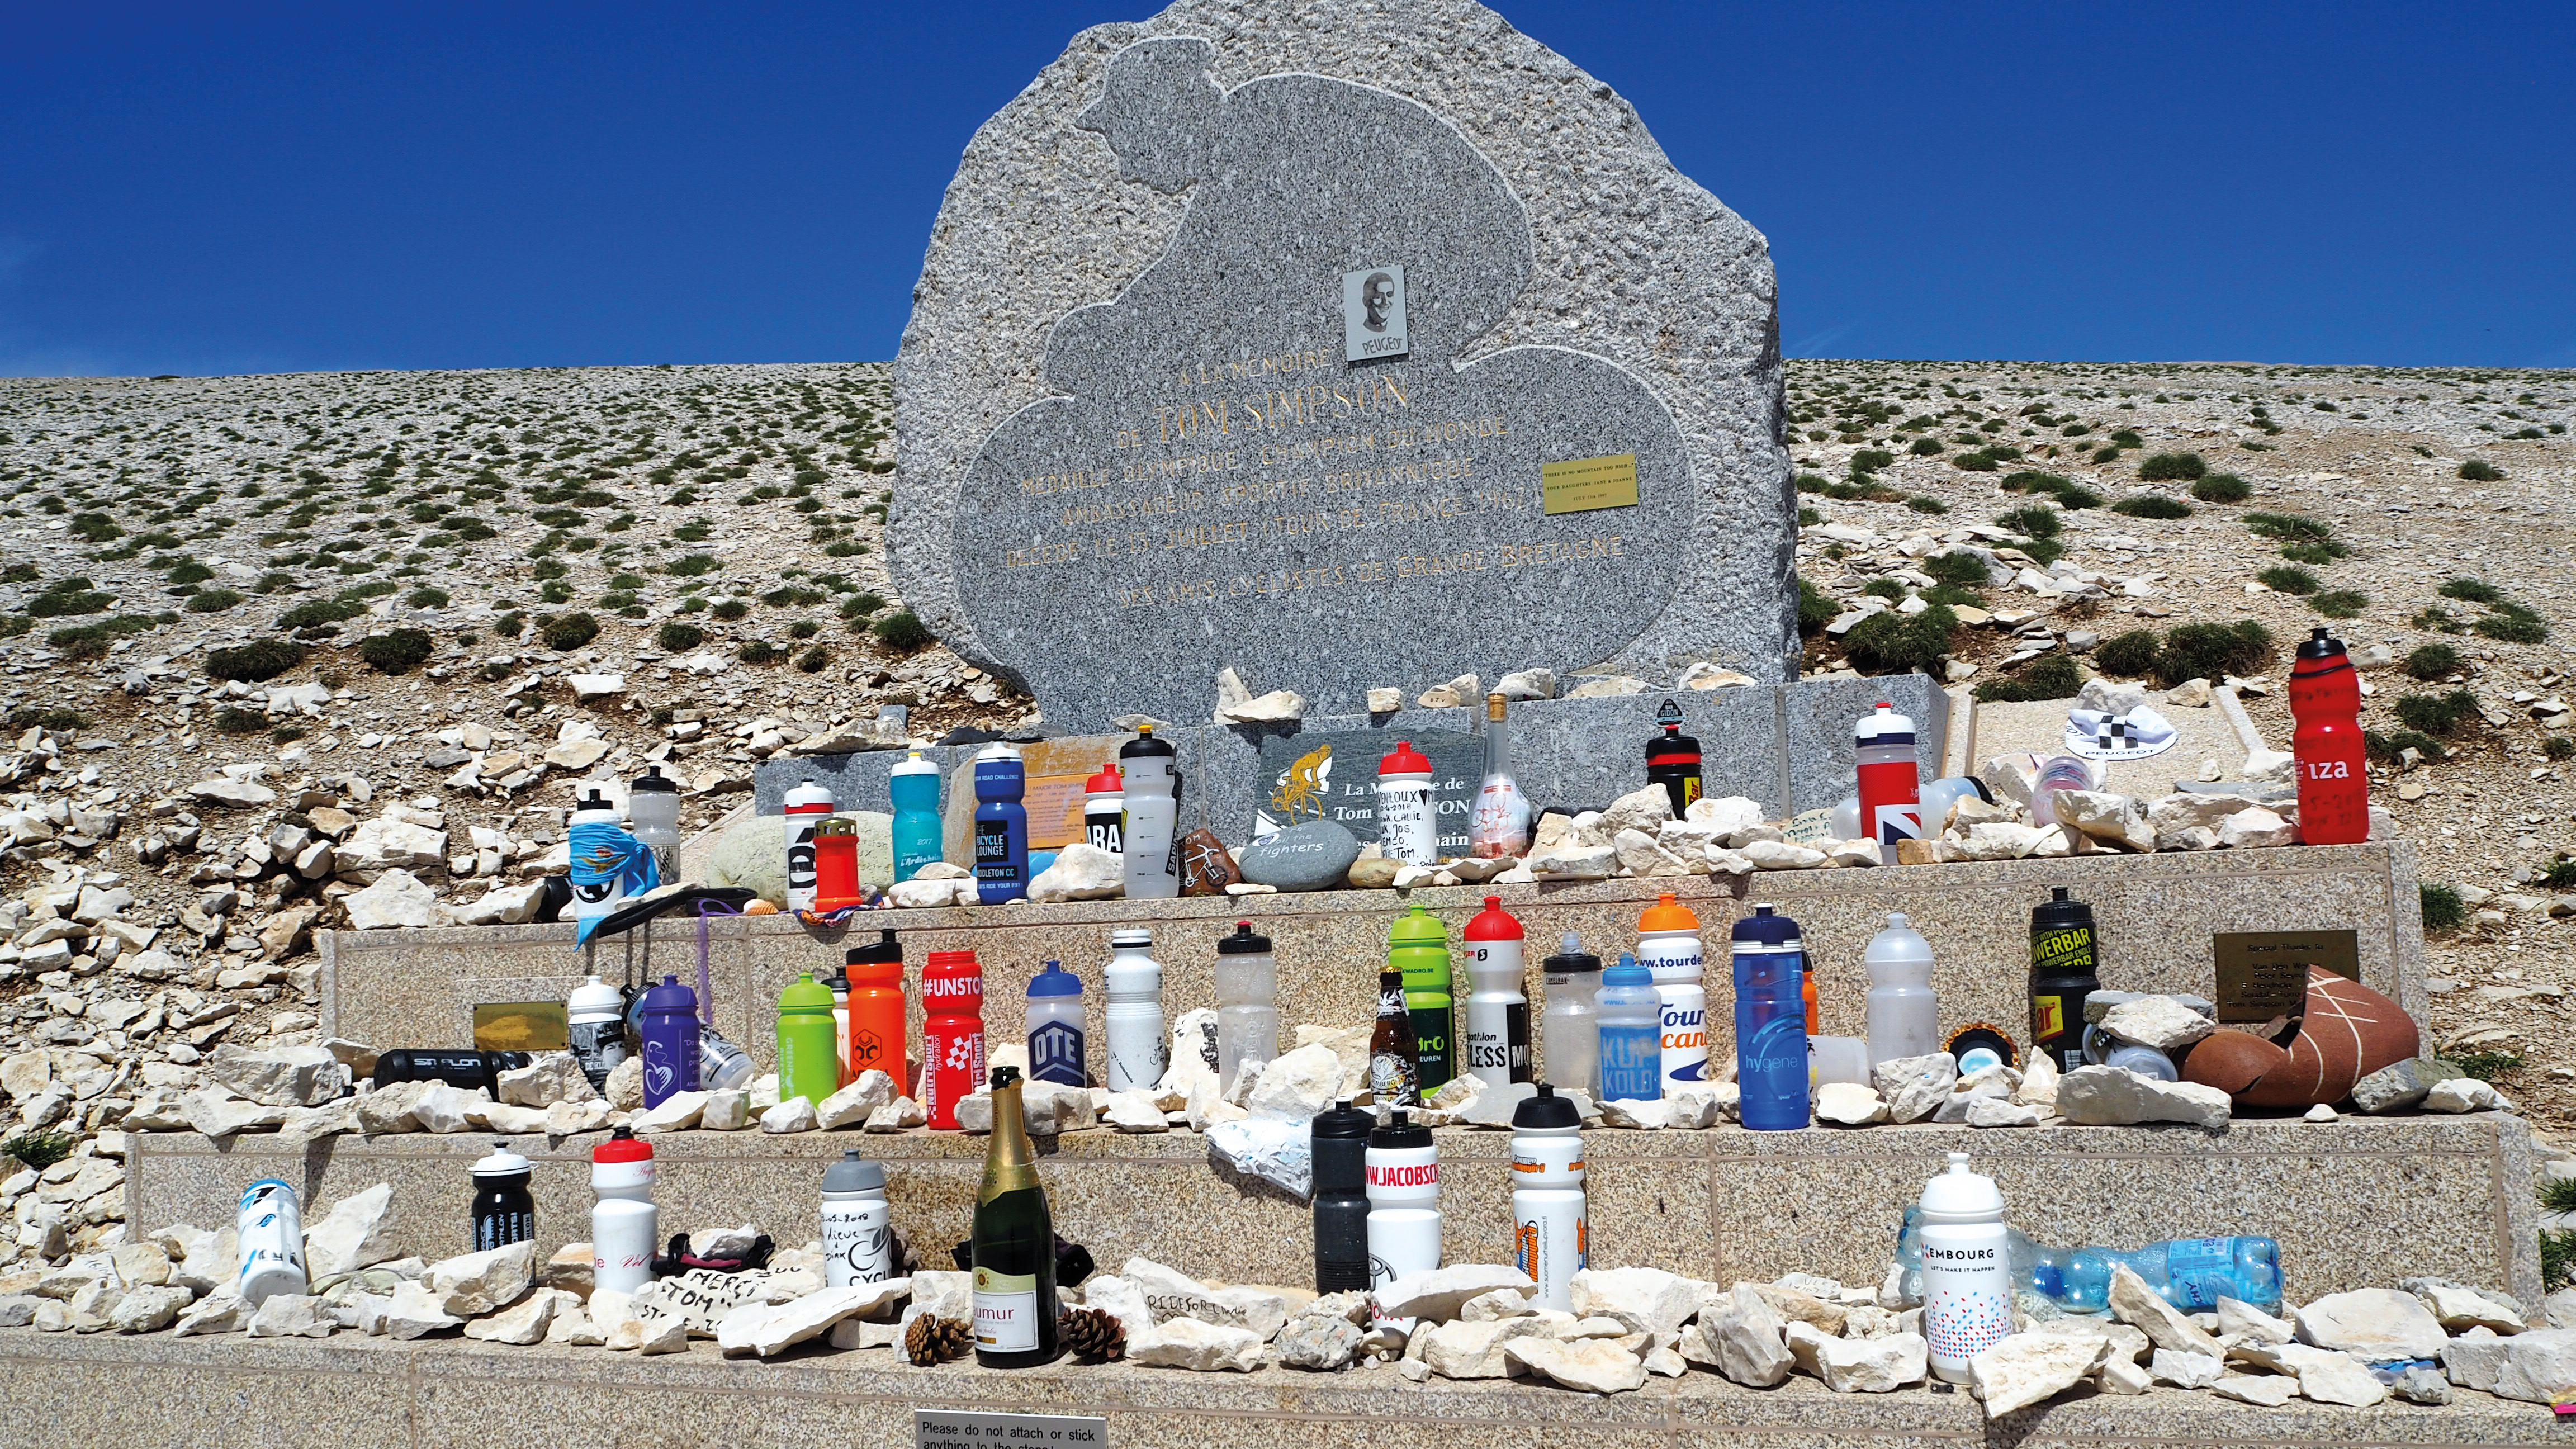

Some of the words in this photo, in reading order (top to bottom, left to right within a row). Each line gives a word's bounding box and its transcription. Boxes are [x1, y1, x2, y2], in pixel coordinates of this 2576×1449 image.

[1362, 337, 1403, 355] PEUGEOT
[1119, 429, 1144, 448] DE
[1155, 399, 1229, 443] TOM
[1245, 375, 1408, 430] SIMPSON
[1124, 451, 1239, 483] OLYMPIQUE
[1262, 433, 1374, 465] CHAMPION
[1388, 427, 1414, 449] DU
[1427, 416, 1508, 444] MONDE
[1063, 491, 1205, 526] AMBASSADEUR
[1222, 479, 1310, 506] SPORTIF
[1165, 521, 1248, 548] JUILLET
[1342, 508, 1366, 529] DE
[1379, 497, 1468, 524] FRANCE
[1360, 561, 1386, 582] DE
[1397, 550, 1485, 579] GRANDE
[1500, 536, 1625, 567] BRETAGNE
[1660, 709, 1678, 717] GIDON
[1344, 784, 1365, 797] La
[1445, 777, 1465, 790] de
[1334, 806, 1372, 820] Tom
[977, 845, 1004, 856] LOUNGE
[1259, 843, 1324, 859] fighters
[1006, 868, 1015, 877] CC
[934, 1034, 943, 1071] hydration
[1035, 1027, 1076, 1066] OTE
[1467, 1044, 1506, 1068] LESS
[1746, 1054, 1798, 1072] hygene
[1604, 1069, 1652, 1094] KOLO
[1929, 1248, 1994, 1260] EMBOURG
[922, 1421, 958, 1435] Please
[965, 1423, 979, 1436] do
[986, 1426, 1003, 1437] not
[1010, 1426, 1044, 1439] attach
[1050, 1430, 1062, 1439] or
[1068, 1429, 1095, 1442] stick
[923, 1439, 970, 1449] anything
